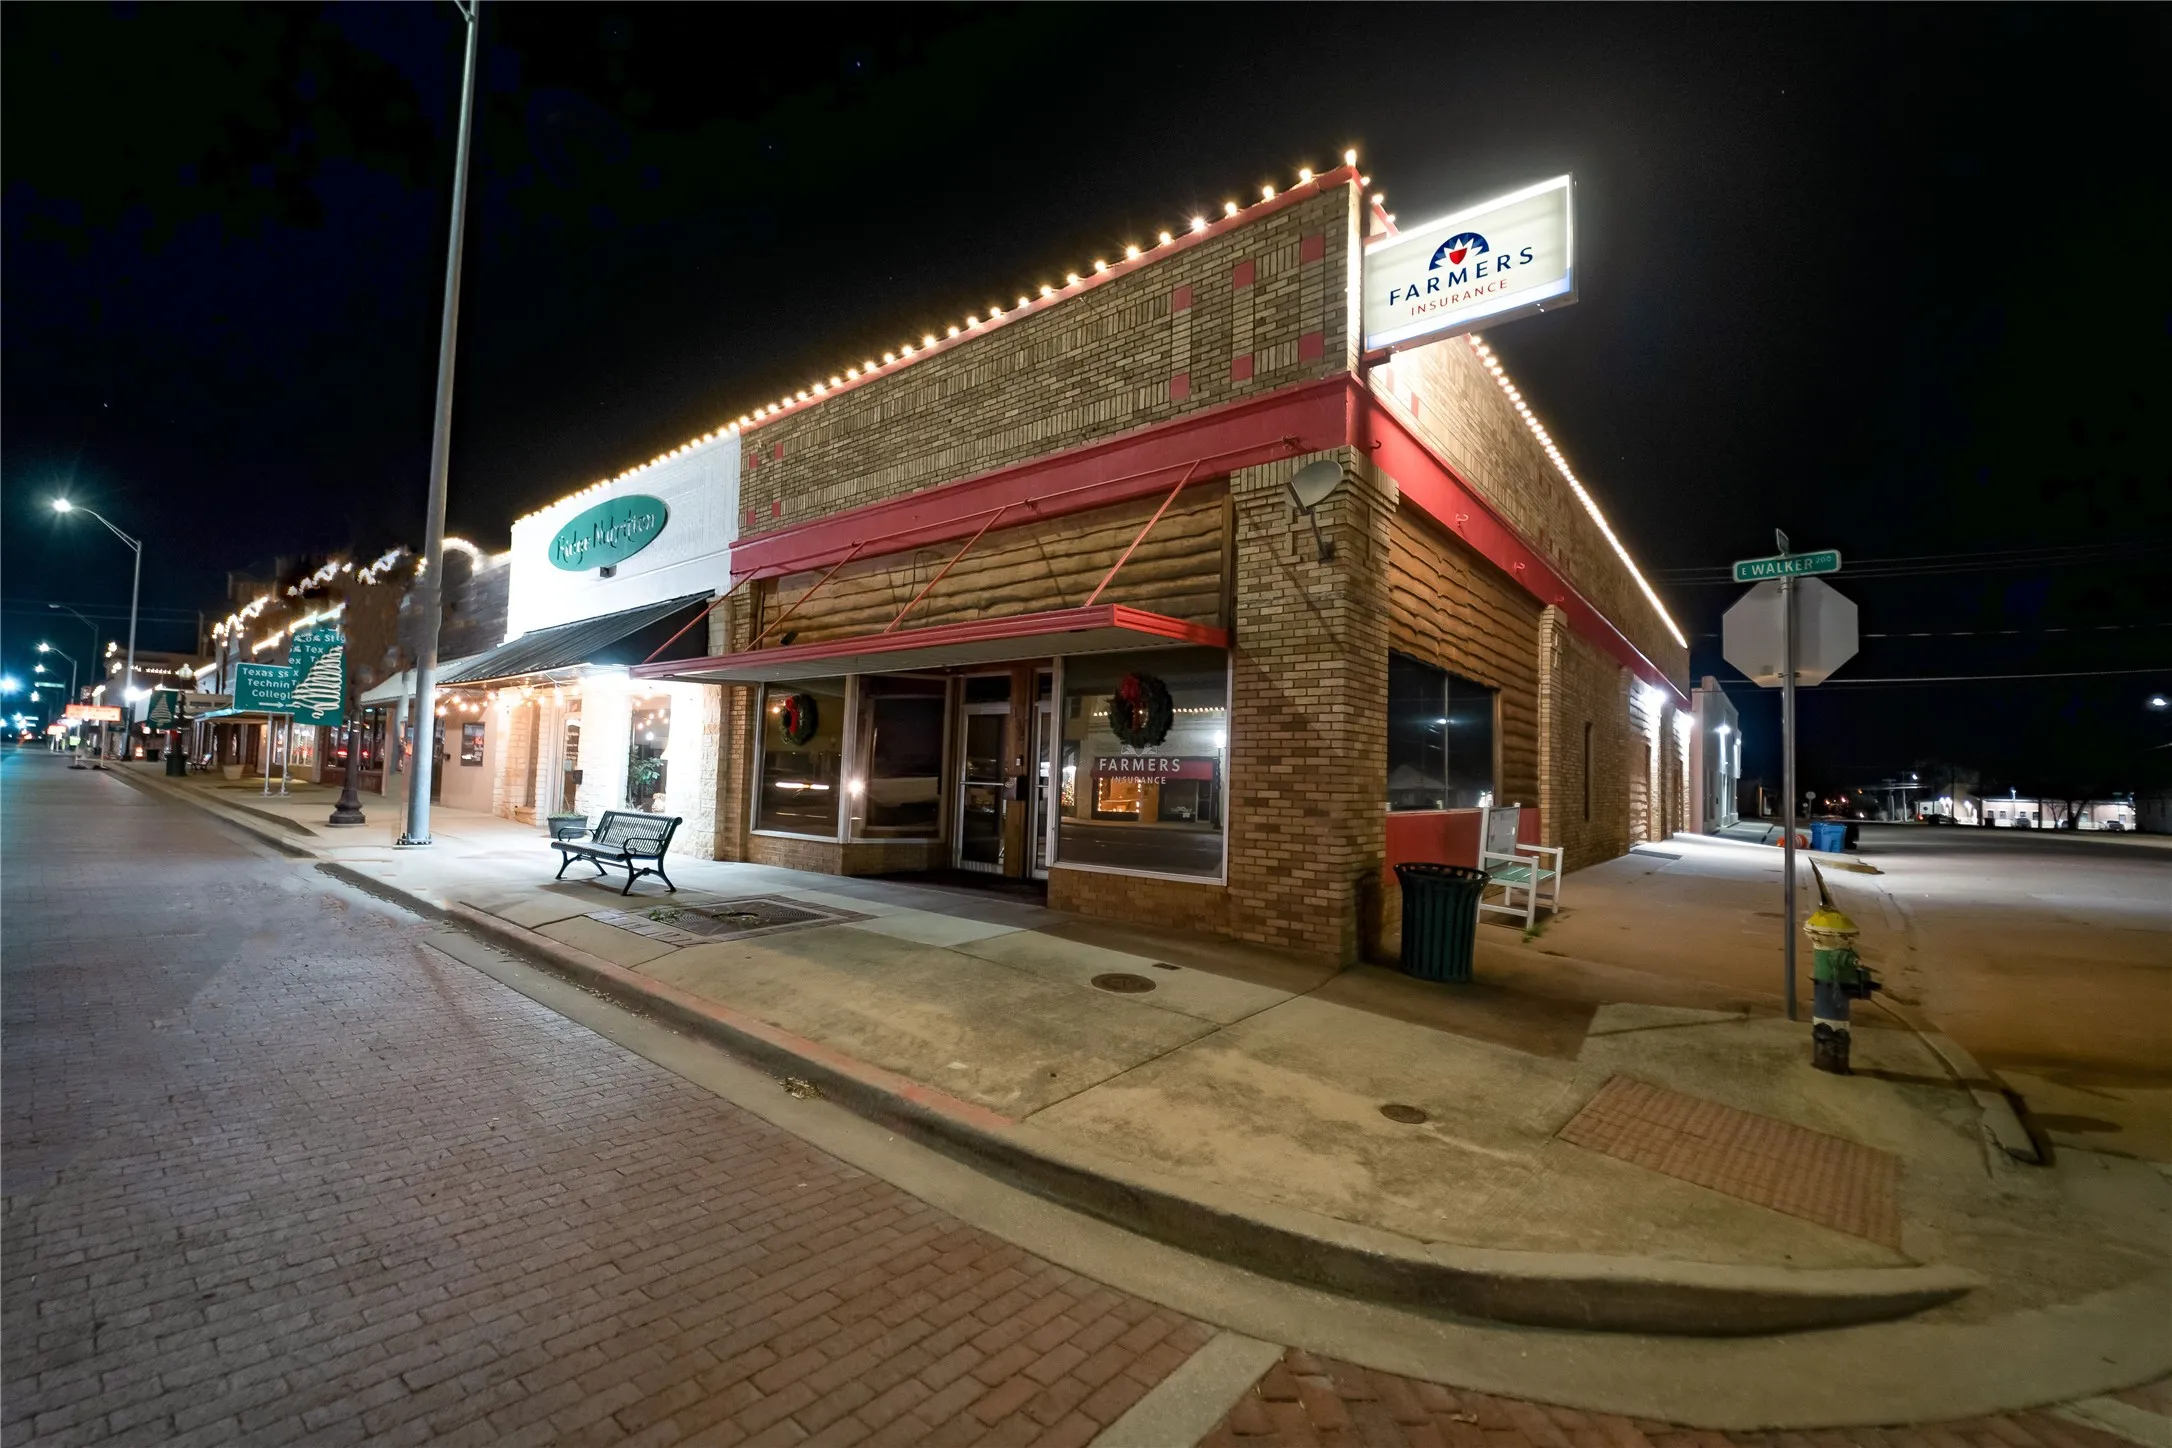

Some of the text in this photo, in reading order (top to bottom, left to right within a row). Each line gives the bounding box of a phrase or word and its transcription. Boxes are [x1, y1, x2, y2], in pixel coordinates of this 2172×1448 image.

[1389, 246, 1534, 306] FARMERS
[1411, 278, 1509, 316] INSURANCE
[1741, 567, 1747, 576] E
[1751, 558, 1813, 576] WALKER
[242, 667, 274, 678] Texas
[1099, 758, 1181, 772] FARMERS
[1111, 776, 1167, 785] INSURANCE
